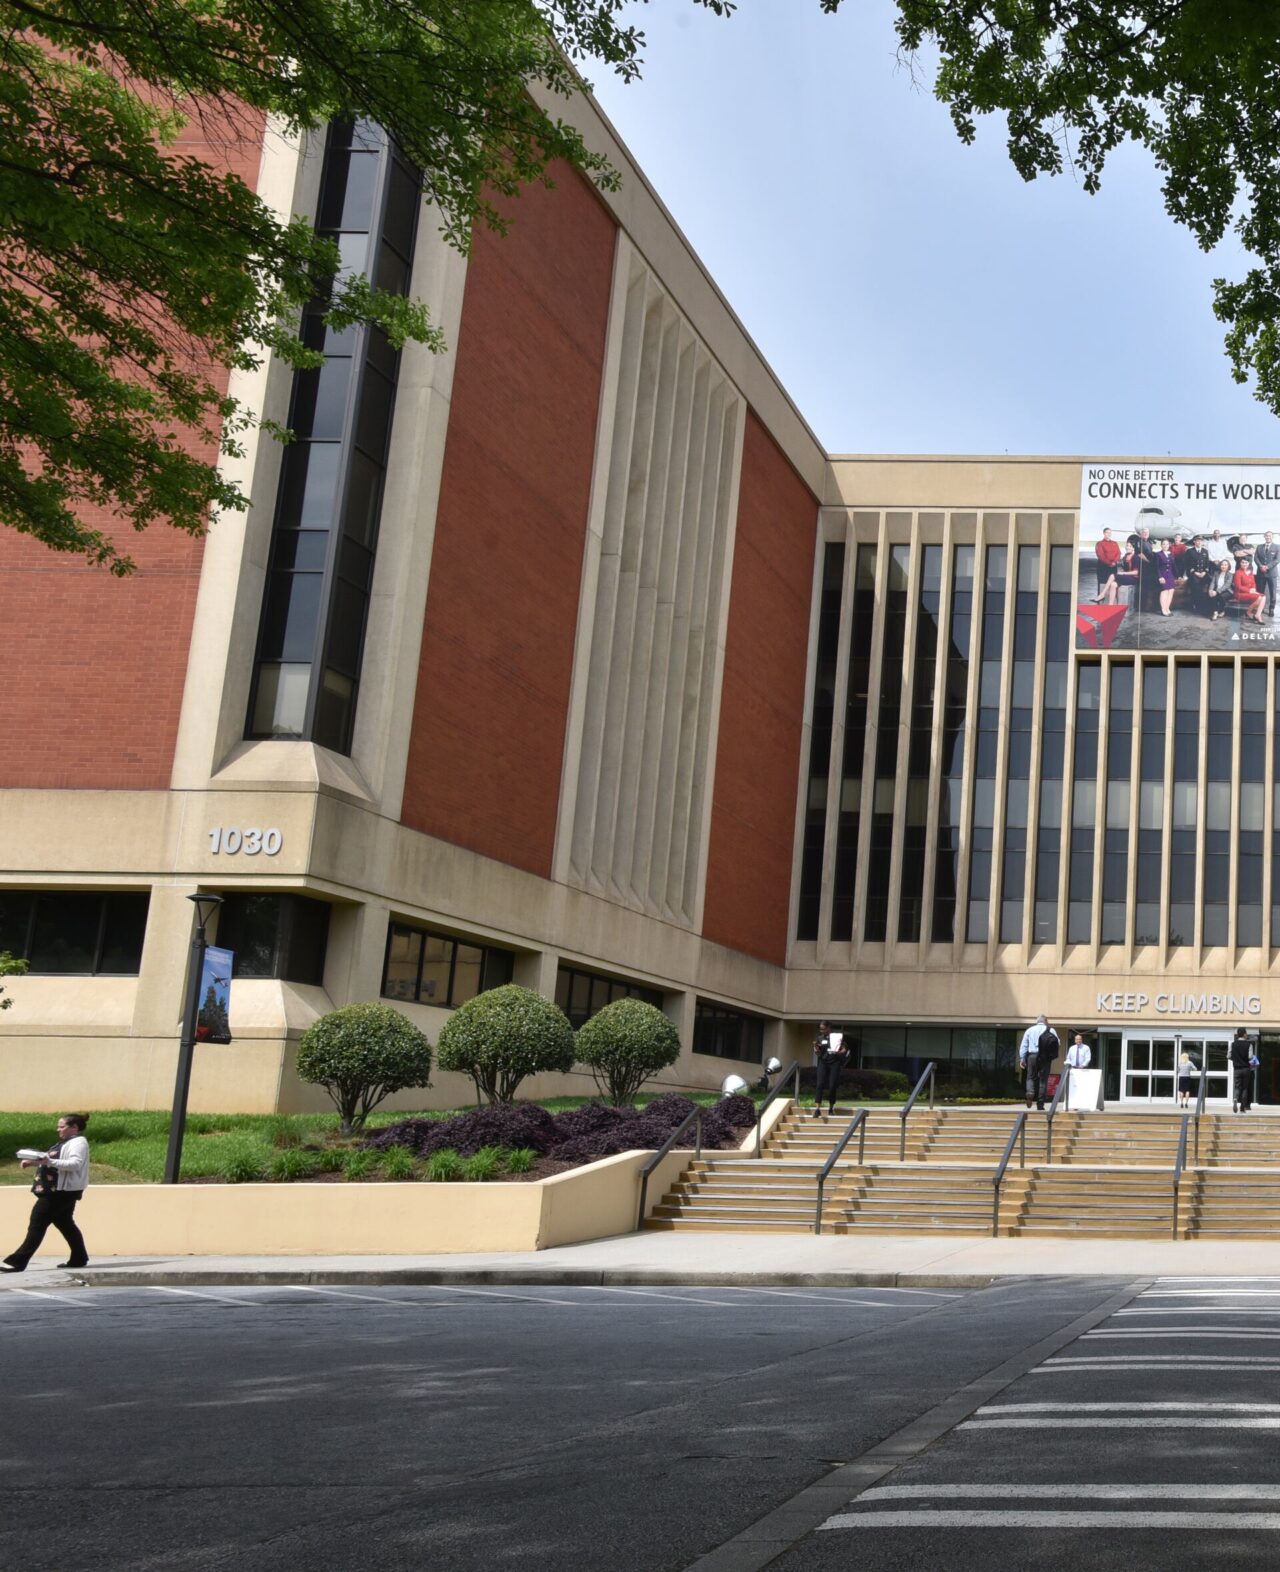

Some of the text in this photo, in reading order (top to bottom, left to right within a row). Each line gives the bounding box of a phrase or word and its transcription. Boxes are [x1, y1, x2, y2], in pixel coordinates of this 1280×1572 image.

[1088, 469, 1174, 481] NO ONE BETTER
[1087, 481, 1179, 499] CONNECTS
[1184, 482, 1218, 500] THE
[1242, 633, 1275, 641] DELTA
[208, 826, 284, 856] 1030
[1096, 991, 1262, 1015] KEEP CLIMBING
